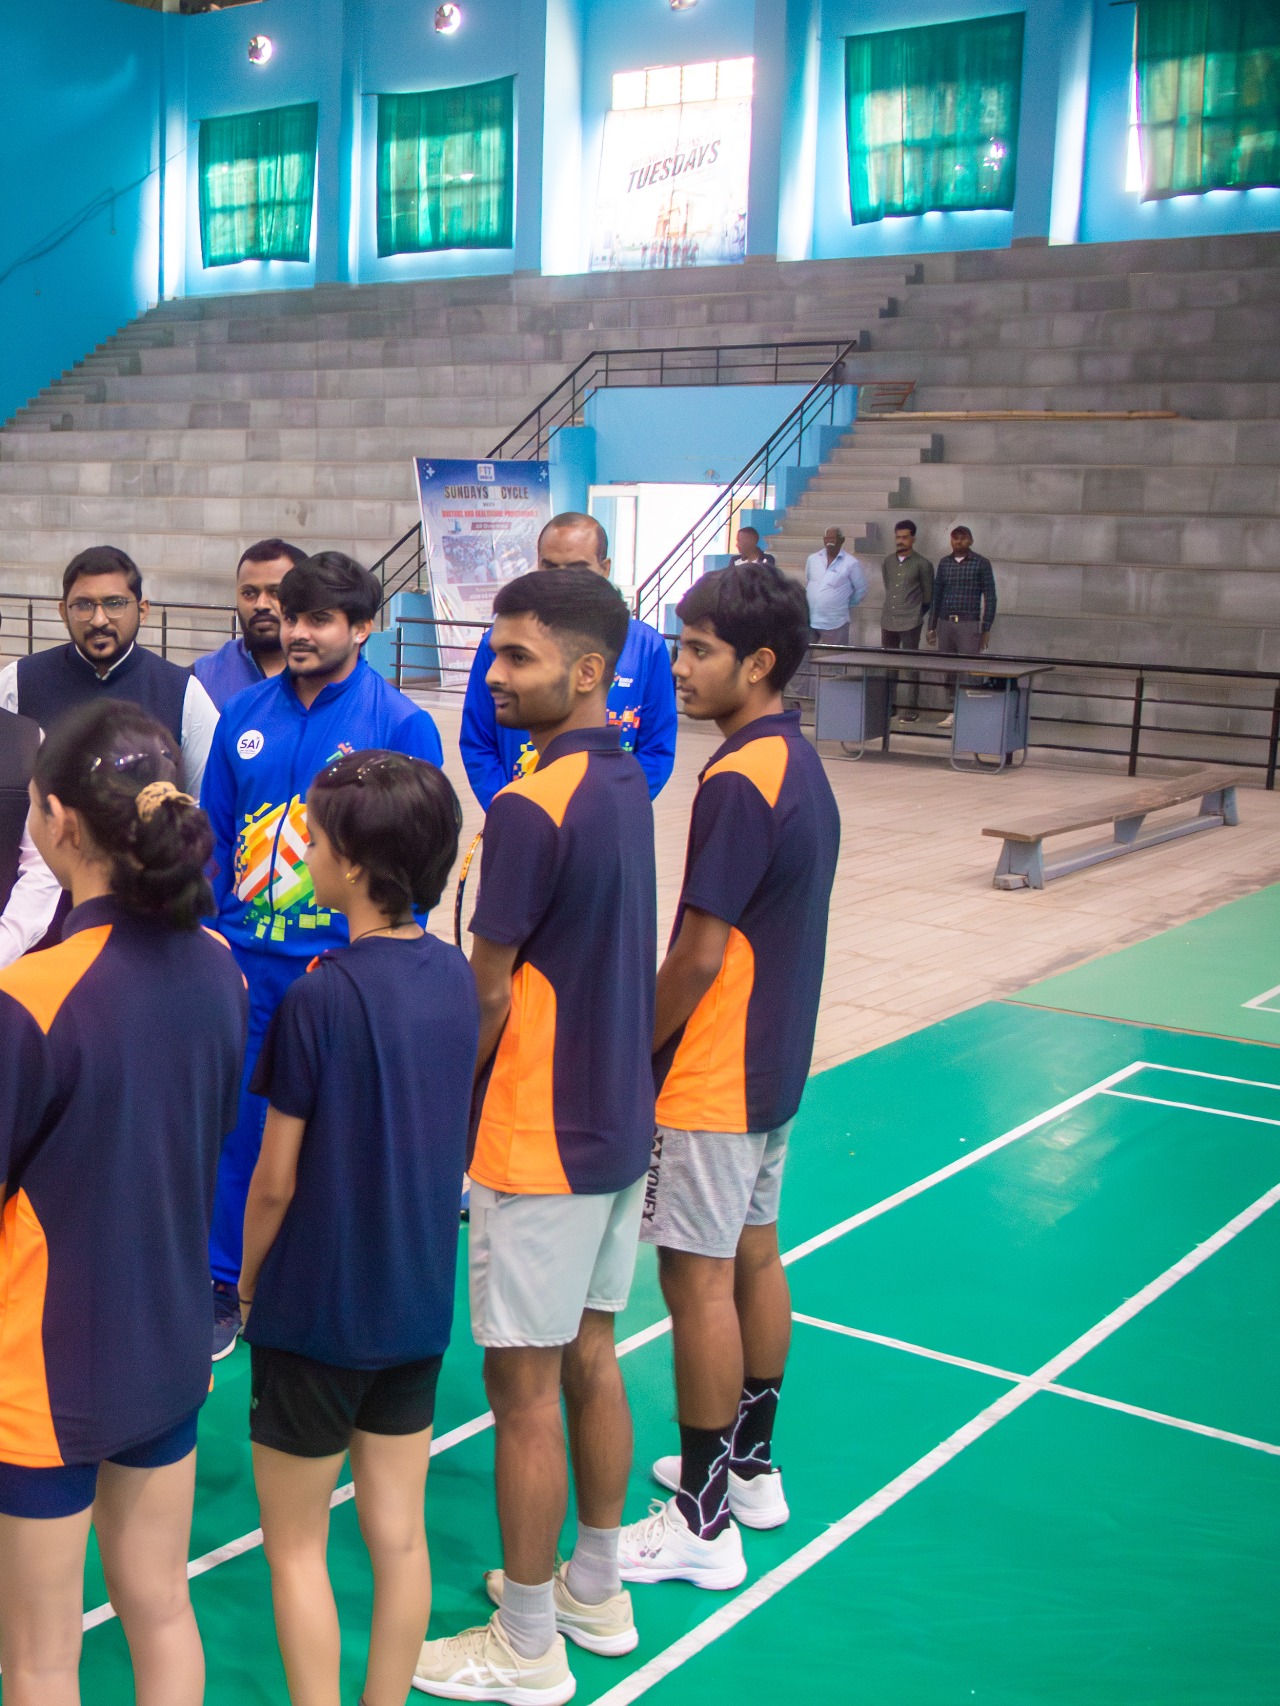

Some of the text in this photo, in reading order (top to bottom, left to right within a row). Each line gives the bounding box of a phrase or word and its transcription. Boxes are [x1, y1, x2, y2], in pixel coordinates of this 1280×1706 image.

[627, 139, 721, 193] TUESDAYS
[479, 466, 493, 475] FIT
[444, 486, 489, 499] SUNDAYS
[501, 486, 529, 499] CYCLE
[642, 1165, 659, 1222] YONEX
